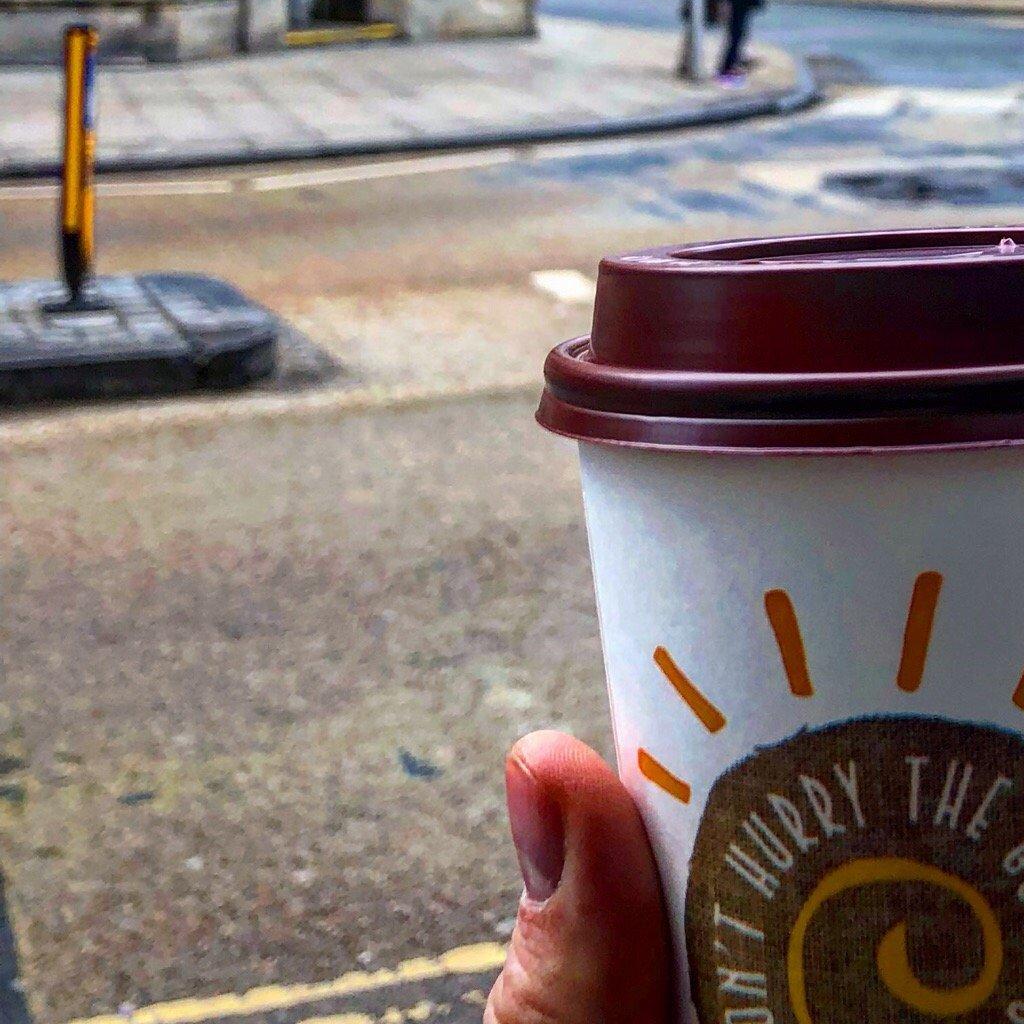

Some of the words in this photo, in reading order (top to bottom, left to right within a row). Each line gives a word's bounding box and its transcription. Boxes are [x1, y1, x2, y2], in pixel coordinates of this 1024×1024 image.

[725, 760, 865, 899] HURRY
[905, 755, 1013, 842] THE
[714, 902, 775, 1024] ON'T
